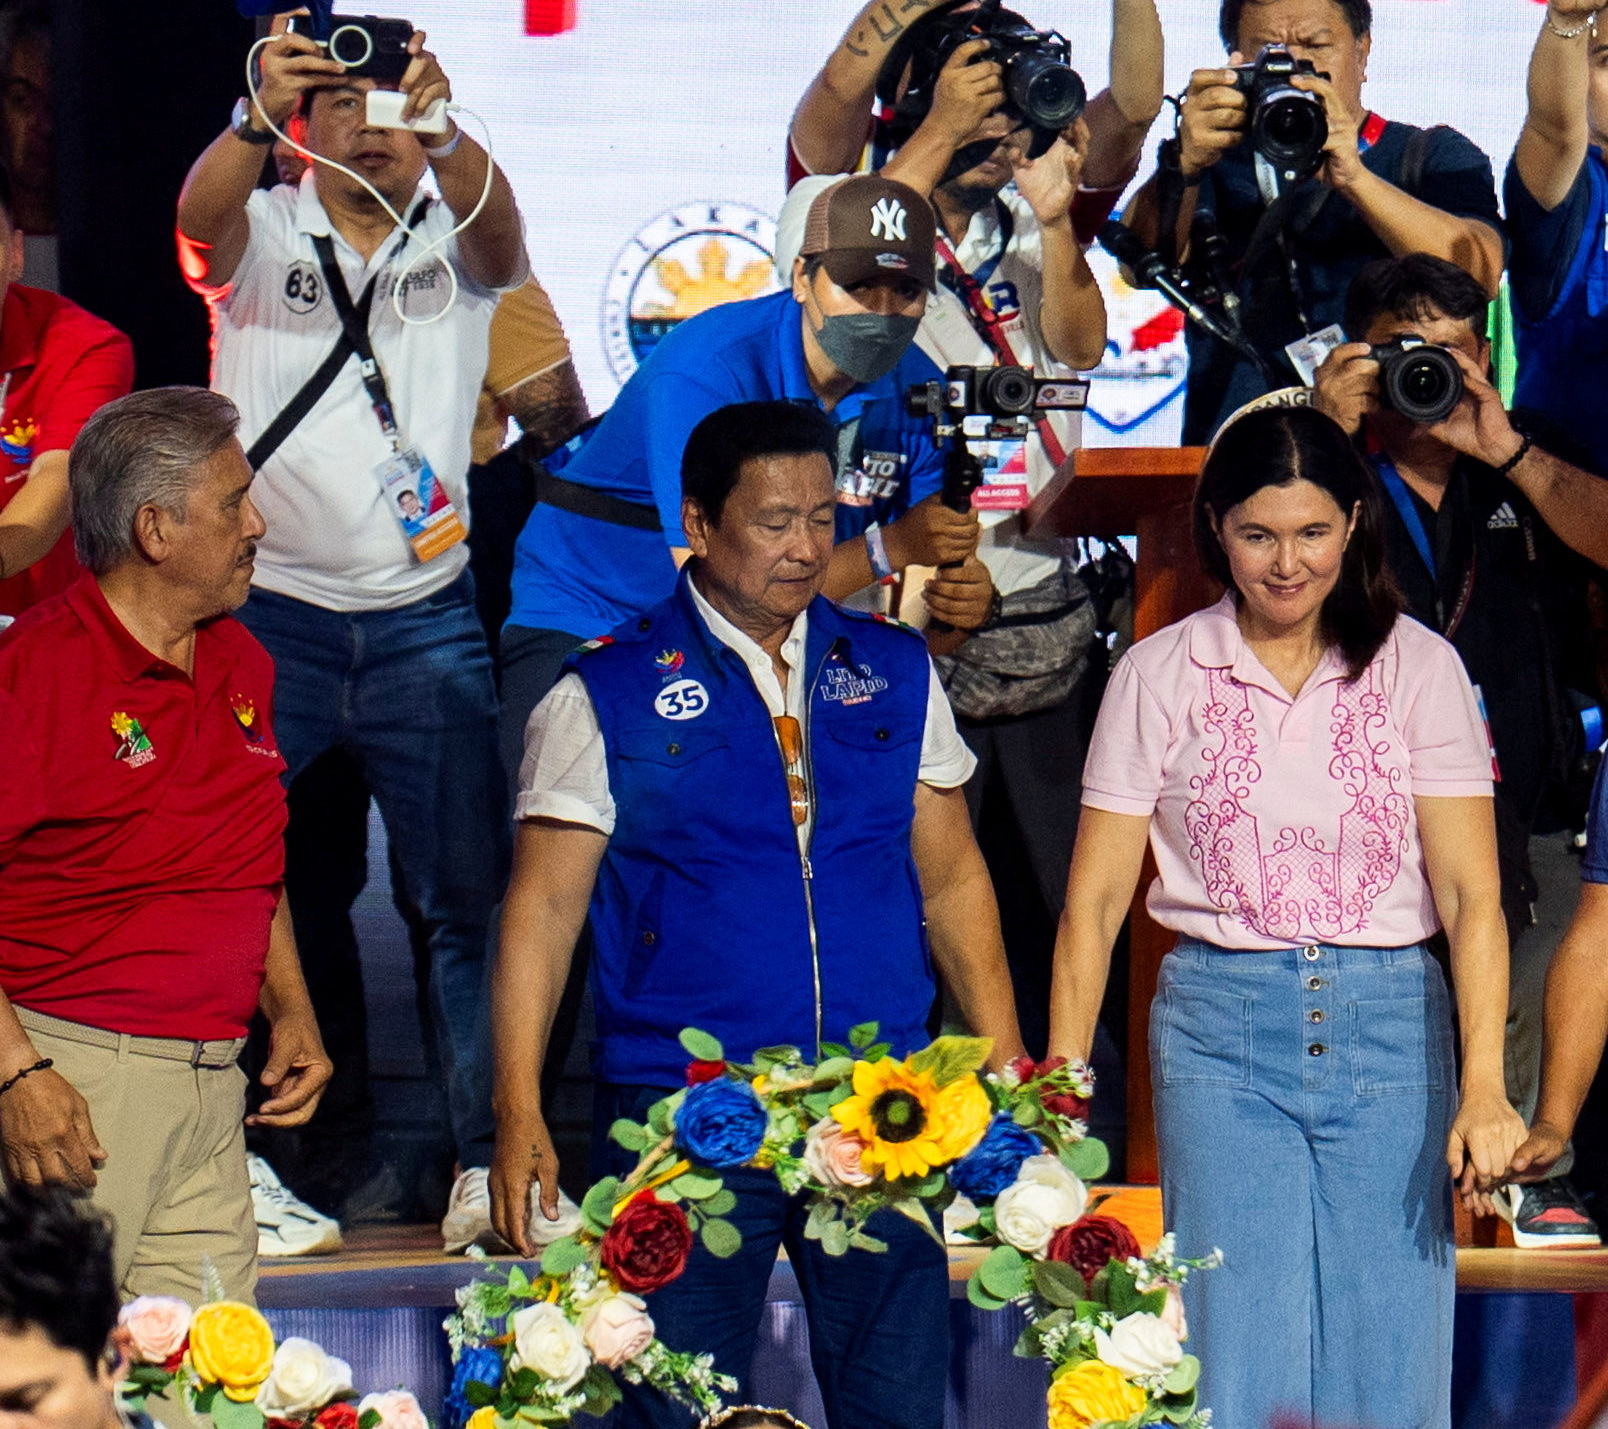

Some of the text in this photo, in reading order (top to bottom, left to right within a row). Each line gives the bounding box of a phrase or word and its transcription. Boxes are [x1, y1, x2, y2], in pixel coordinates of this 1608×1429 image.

[285, 268, 318, 304] 63
[660, 684, 705, 717] 35
[820, 675, 888, 701] LAPID
